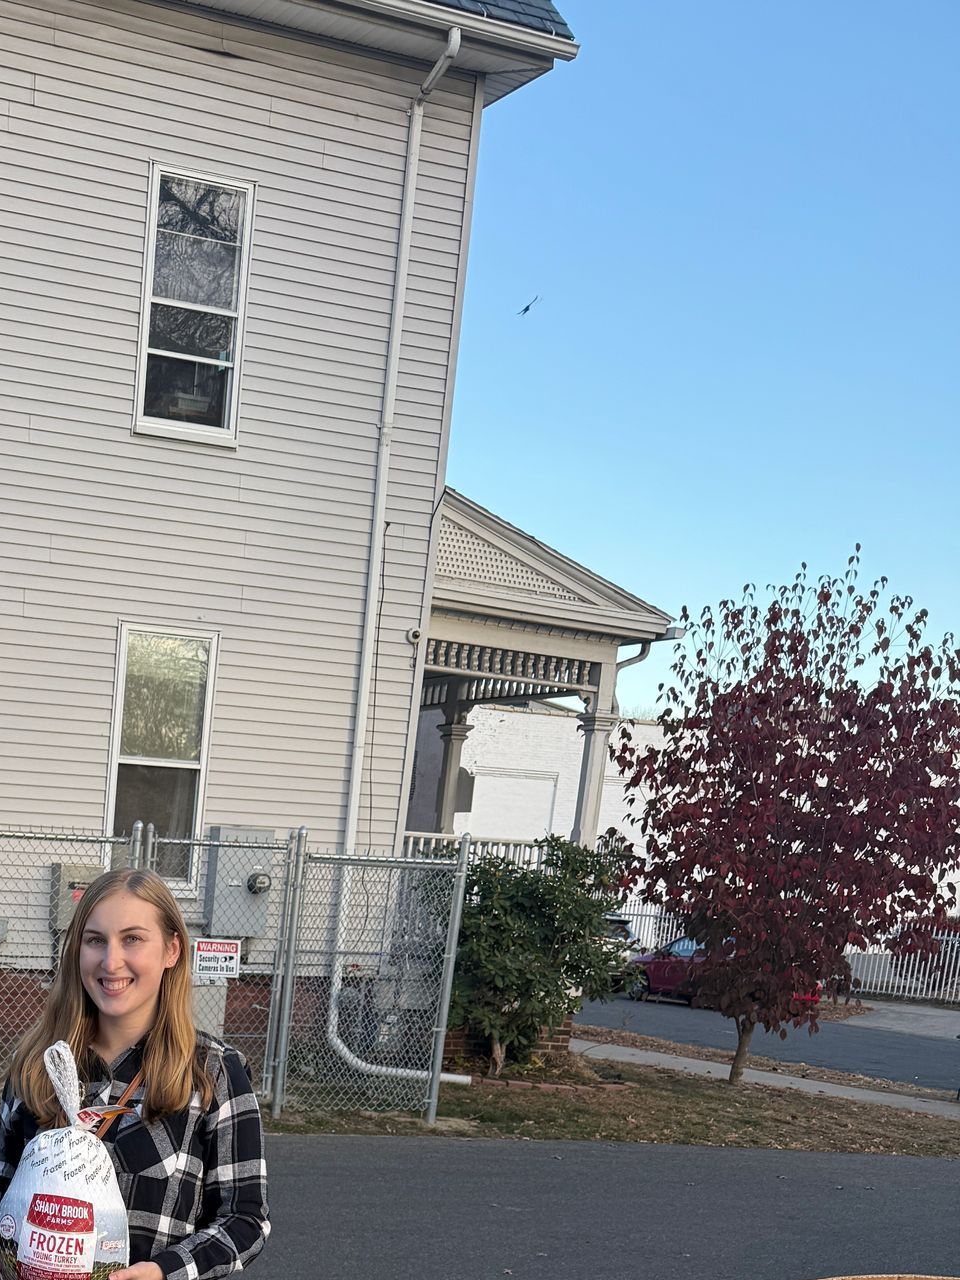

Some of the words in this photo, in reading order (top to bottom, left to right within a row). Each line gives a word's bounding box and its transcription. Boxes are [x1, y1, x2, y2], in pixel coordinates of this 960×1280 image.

[199, 943, 236, 953] WARNING
[199, 954, 220, 964] Security
[198, 964, 219, 972] Cameras
[226, 964, 235, 973] Use
[42, 1158, 67, 1177] frozen
[63, 1163, 87, 1182] frozen
[34, 1200, 60, 1215] SHADY
[61, 1204, 89, 1219] BROOK
[29, 1230, 85, 1256] FROZEN
[33, 1250, 52, 1262] YOUNG
[54, 1254, 78, 1264] TURKEY
